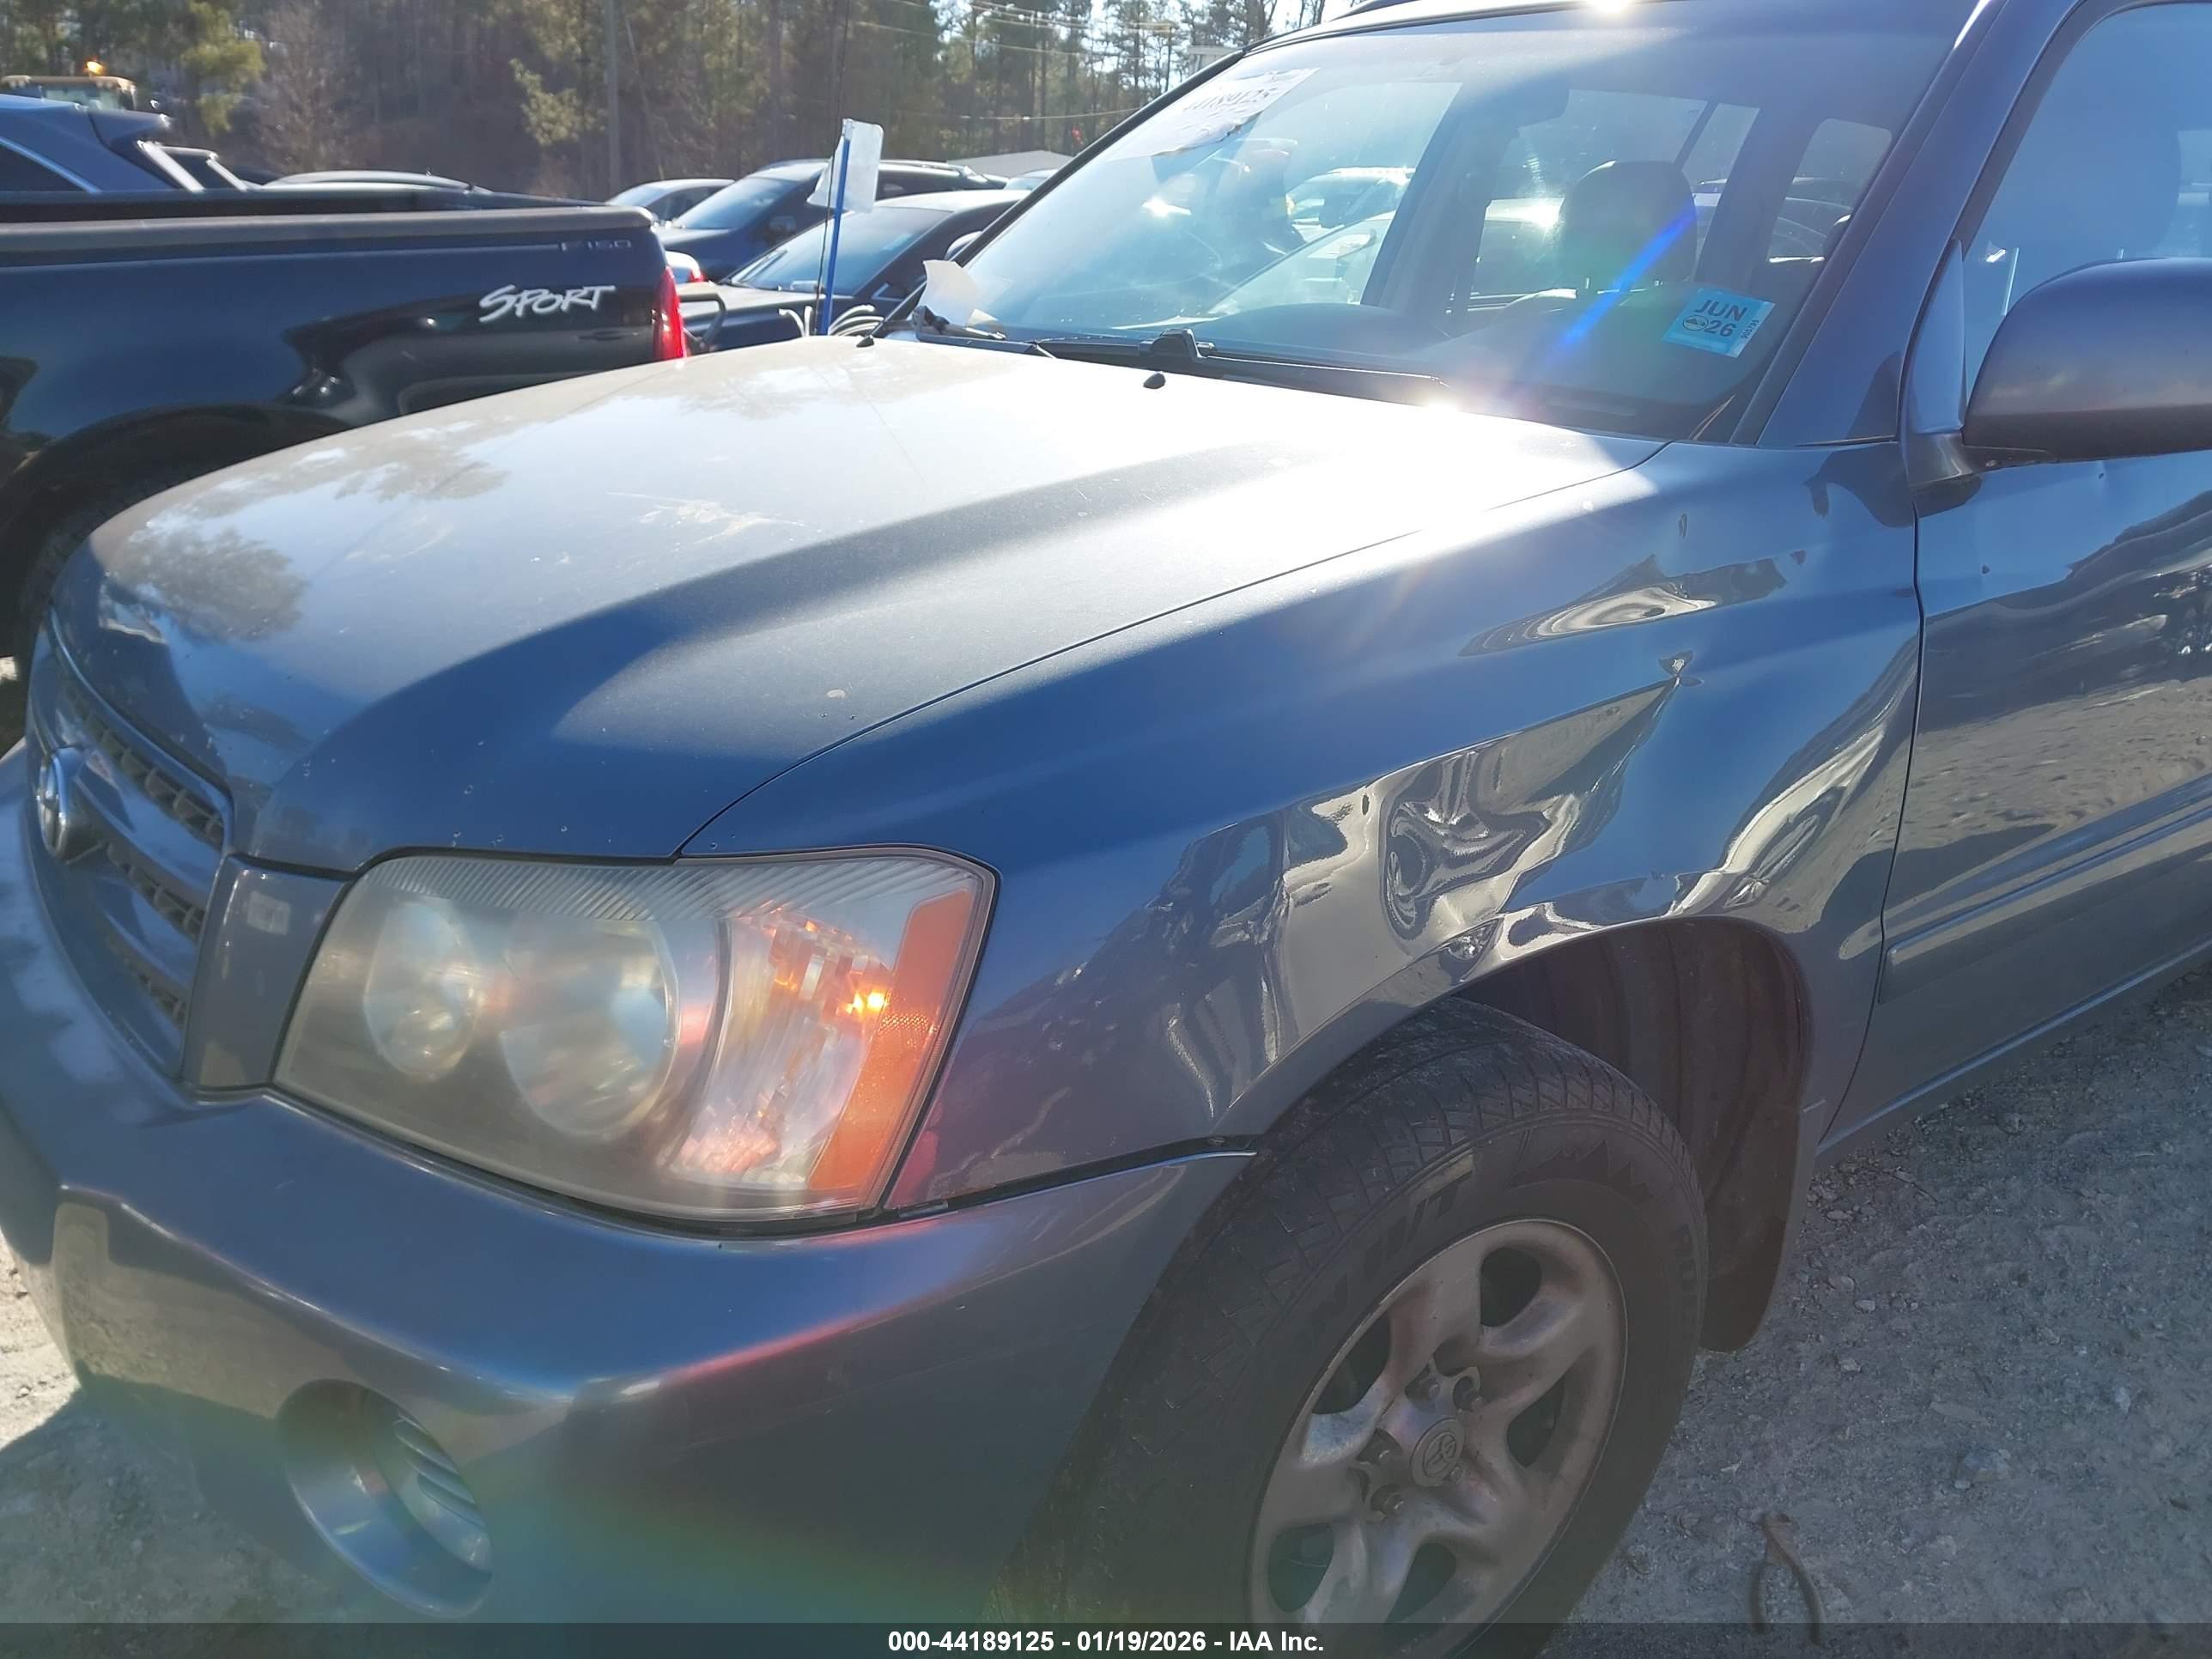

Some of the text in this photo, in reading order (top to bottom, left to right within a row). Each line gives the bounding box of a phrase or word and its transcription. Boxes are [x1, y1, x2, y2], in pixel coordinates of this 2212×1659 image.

[478, 284, 617, 324] SPORT
[1694, 299, 1748, 322] JUN
[1703, 319, 1736, 337] 26
